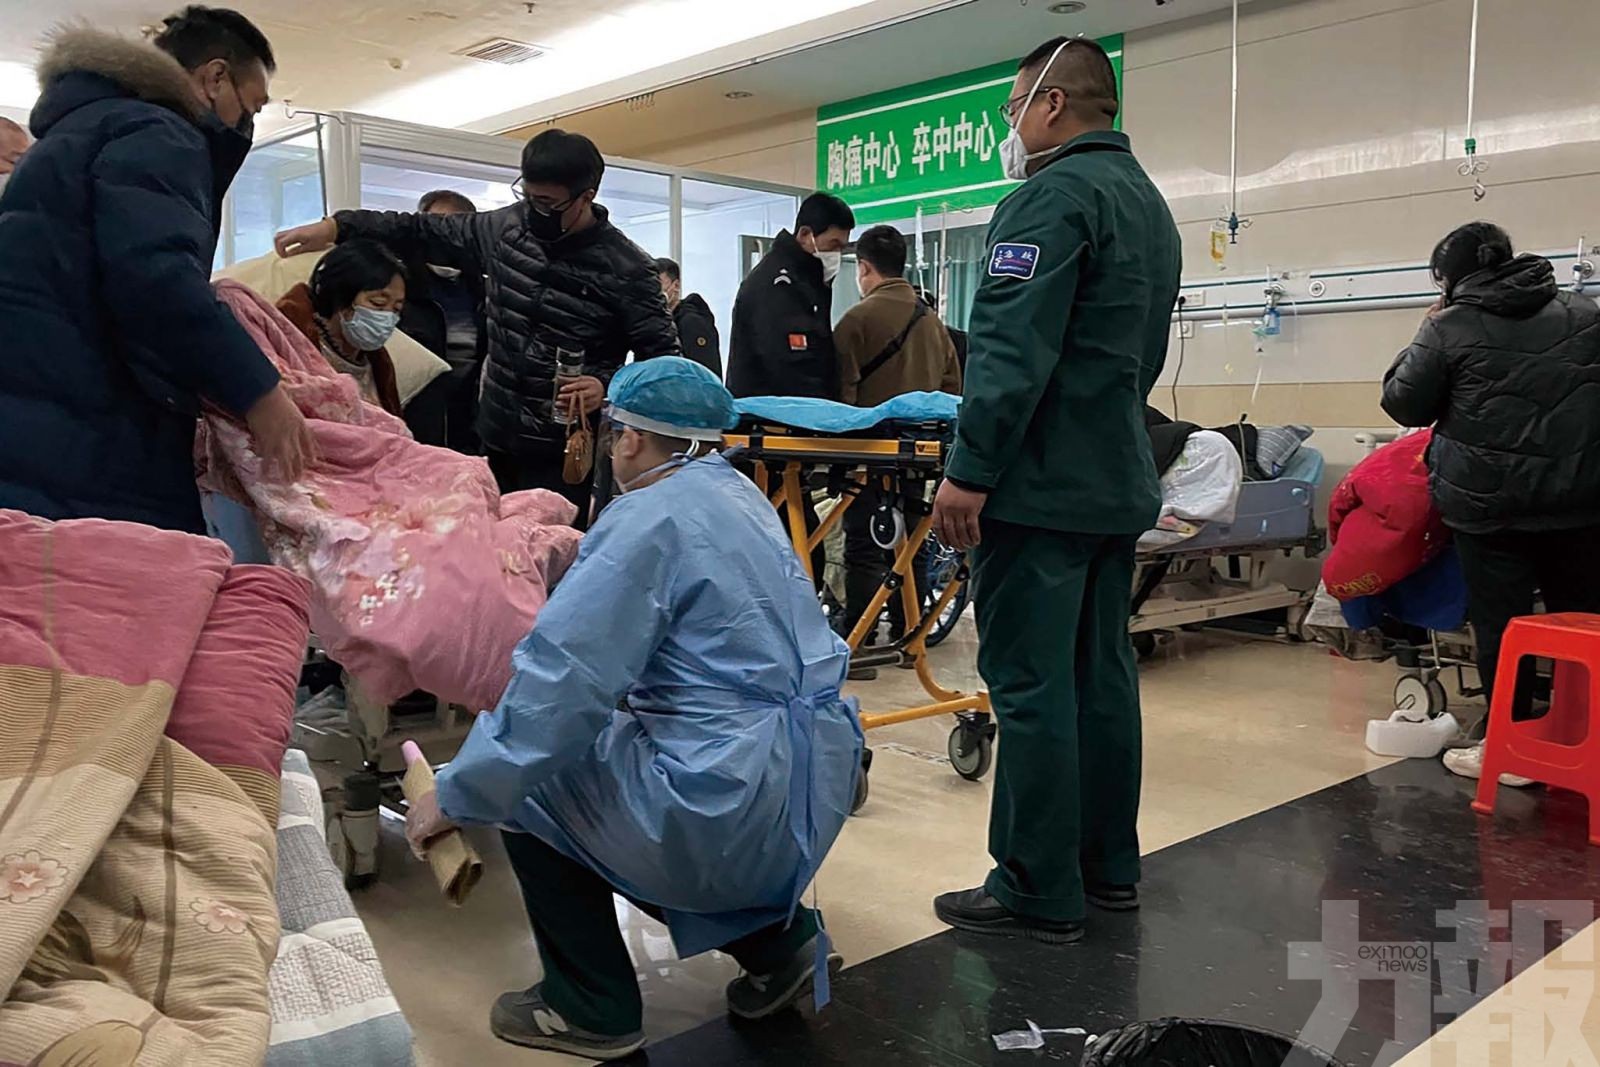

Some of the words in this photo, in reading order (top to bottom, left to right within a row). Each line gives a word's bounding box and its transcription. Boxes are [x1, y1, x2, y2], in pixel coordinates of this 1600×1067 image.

[827, 130, 901, 189] 胸痛中心
[911, 110, 995, 175] 卒中中心
